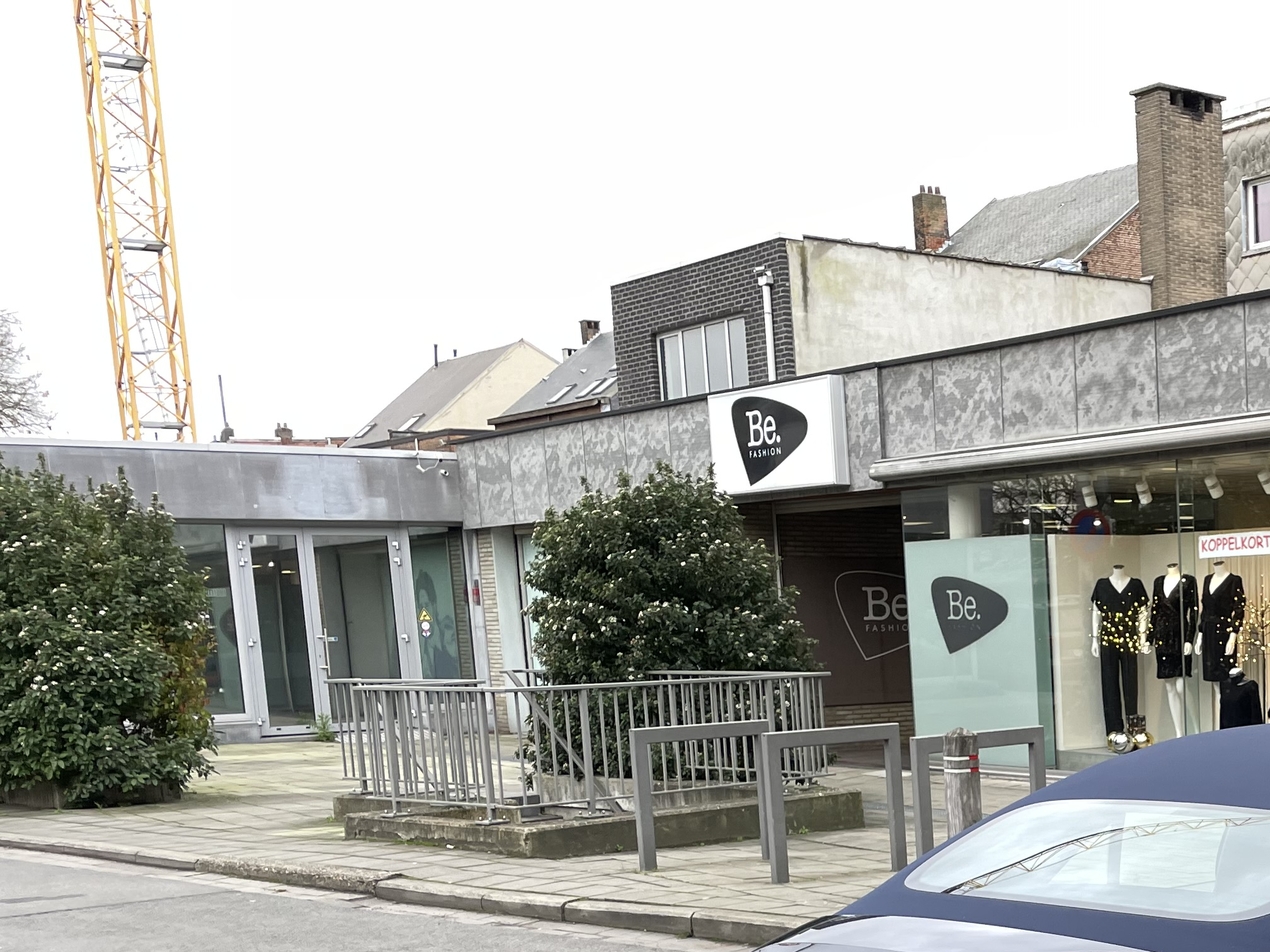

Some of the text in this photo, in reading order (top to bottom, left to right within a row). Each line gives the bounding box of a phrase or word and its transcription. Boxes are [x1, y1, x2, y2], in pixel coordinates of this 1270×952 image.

[745, 410, 781, 447] Be.
[749, 447, 782, 458] FASHION
[861, 586, 908, 621] Be
[946, 589, 981, 620] Be.
[865, 624, 908, 632] FASHIO
